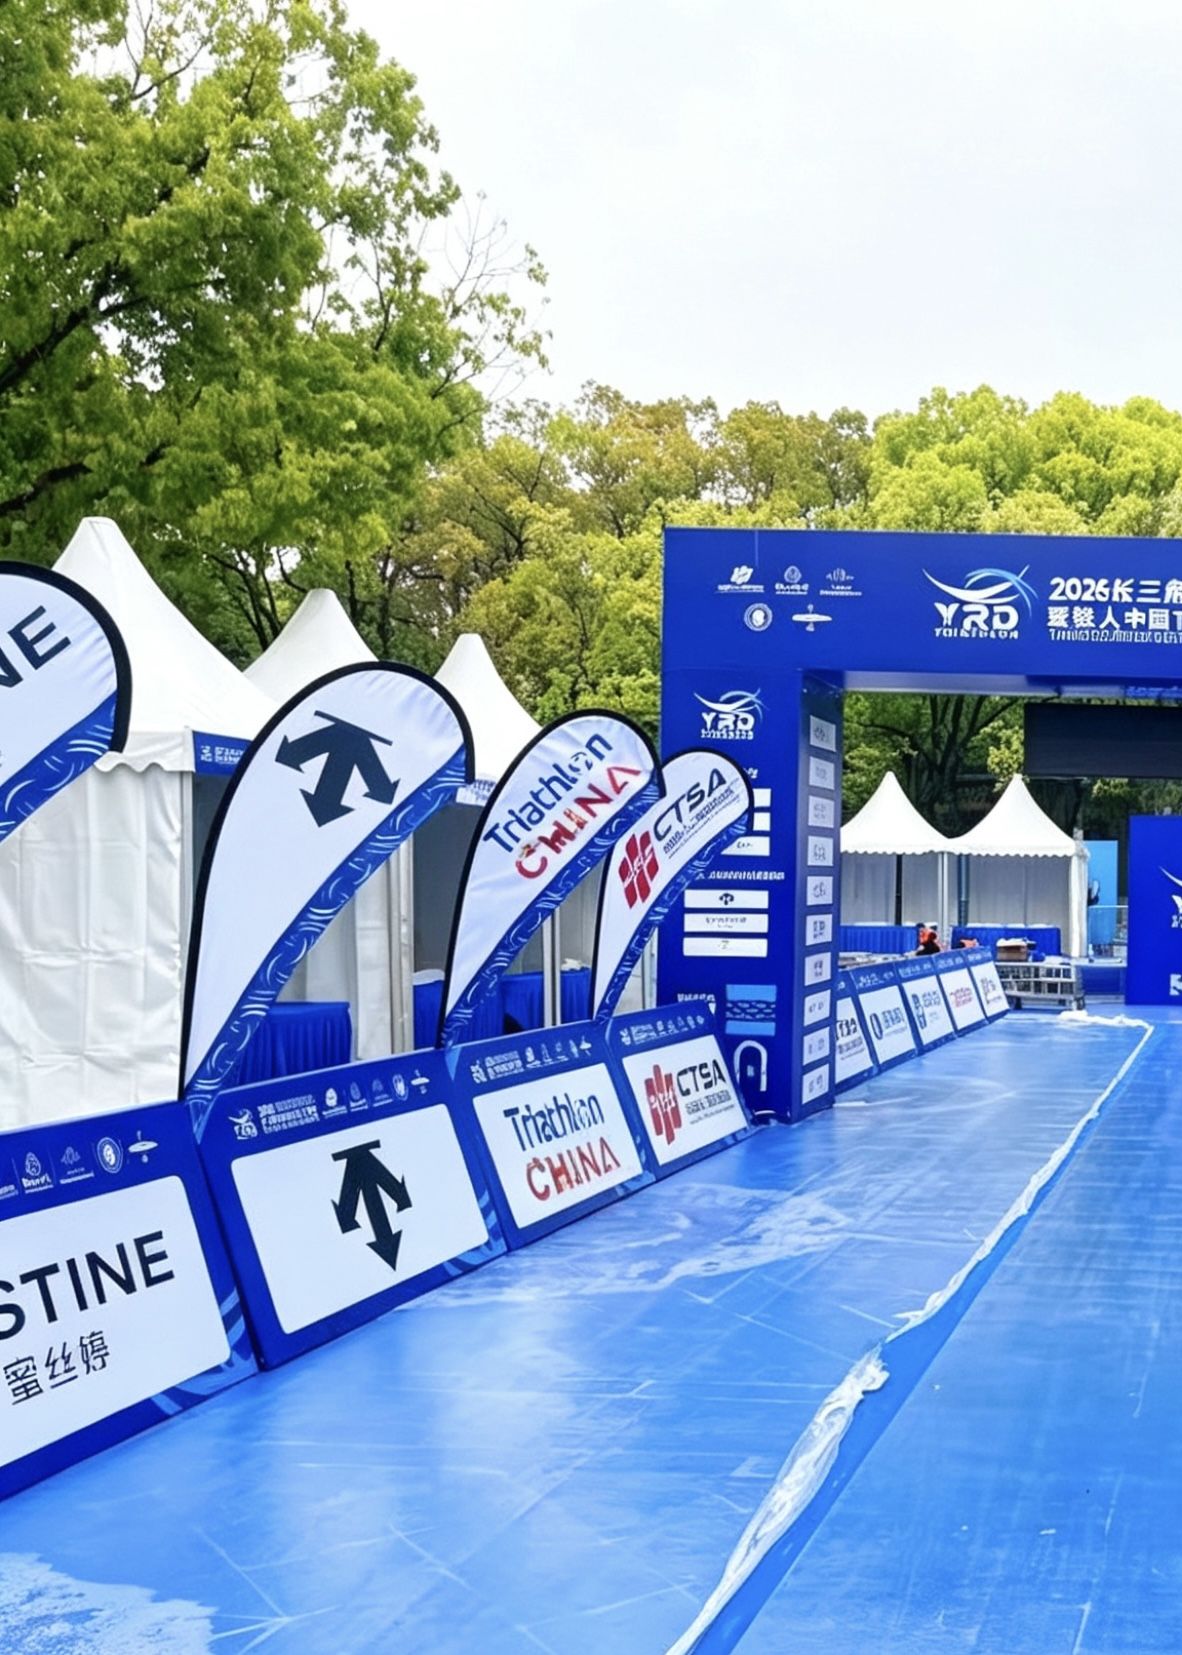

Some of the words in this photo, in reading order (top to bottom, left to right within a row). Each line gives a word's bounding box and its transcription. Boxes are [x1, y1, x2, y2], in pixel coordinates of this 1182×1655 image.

[934, 602, 1019, 631] YRD
[483, 734, 613, 852] Triathlon
[654, 769, 726, 841] CTSA
[677, 1059, 726, 1097] CTSA
[526, 1137, 620, 1201] CHINA
